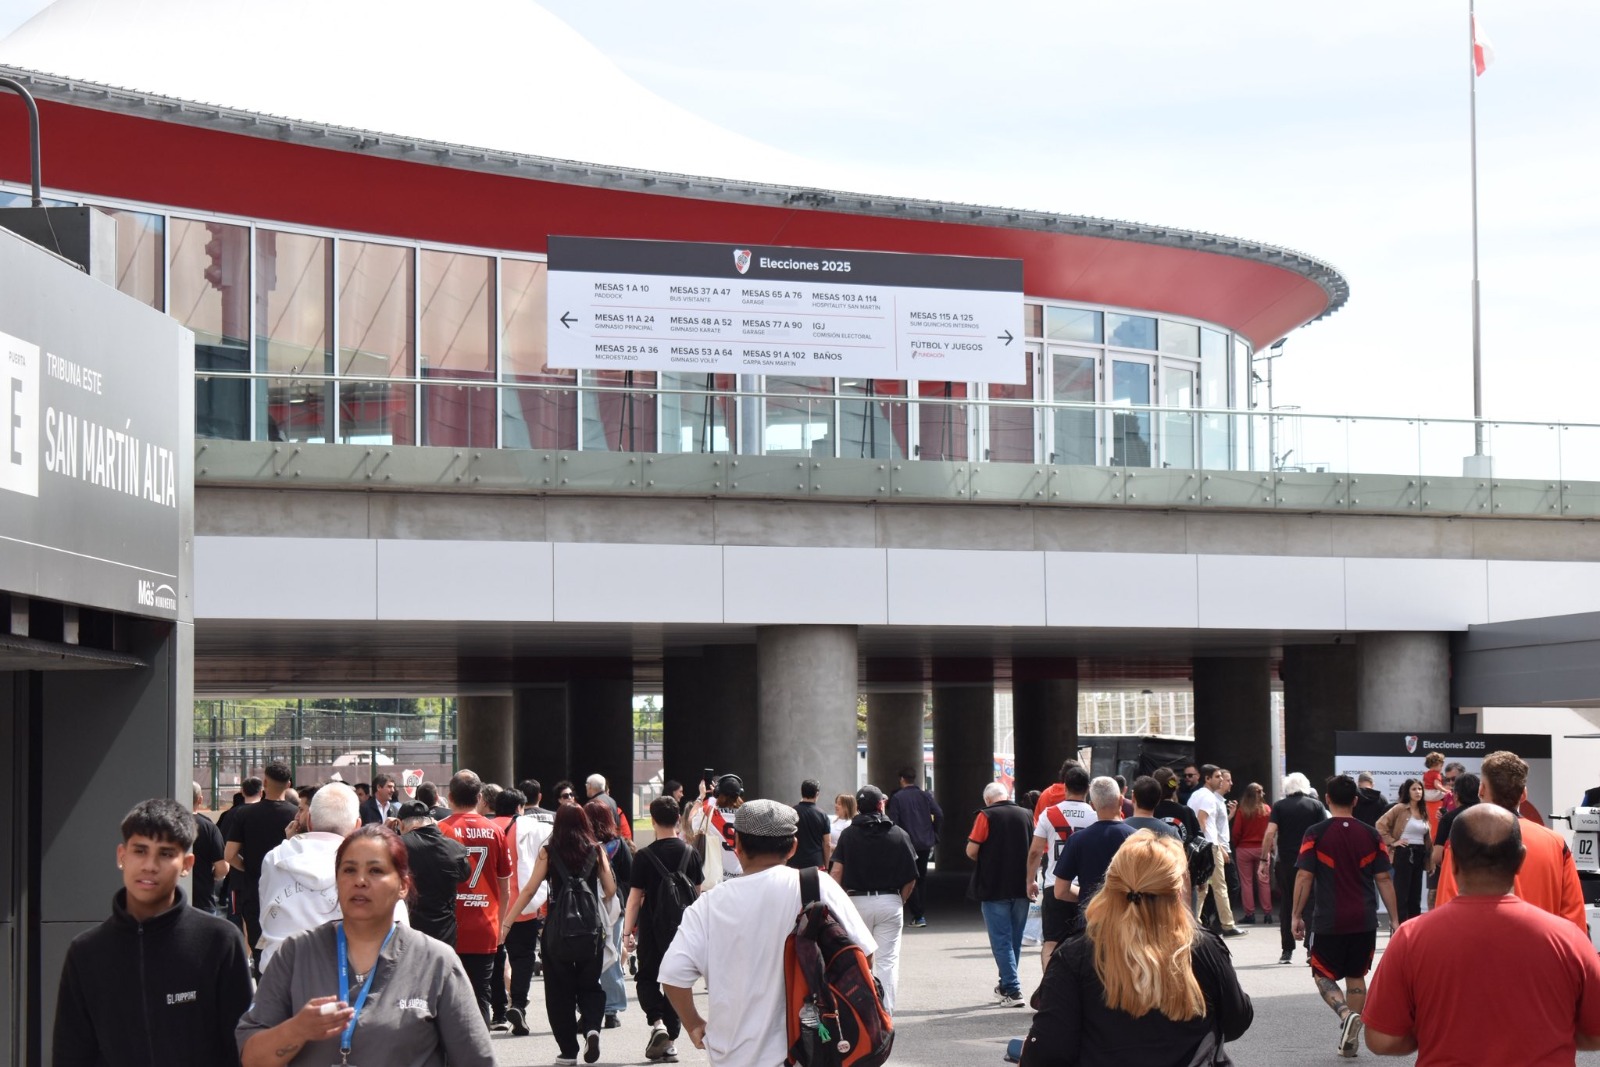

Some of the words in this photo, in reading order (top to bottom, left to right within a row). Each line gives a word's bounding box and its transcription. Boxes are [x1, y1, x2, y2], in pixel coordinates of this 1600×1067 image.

[760, 257, 819, 271] Elecciones
[822, 260, 852, 272] 2025
[594, 283, 624, 292] MESAS
[670, 286, 698, 294] MESAS
[742, 290, 770, 298] MESAS
[812, 292, 840, 301] MESAS
[595, 314, 624, 322] MESAS
[910, 312, 937, 320] MESAS
[670, 317, 699, 325] MESAS
[742, 320, 770, 328] MESAS
[596, 344, 624, 352] MESAS
[910, 340, 942, 350] FÚTBOL
[671, 347, 699, 355] MESAS
[743, 350, 771, 358] MESAS
[814, 351, 842, 360] BAÑOS
[8, 351, 26, 366] PUERTA
[46, 352, 82, 387] TRIBUNA
[83, 368, 102, 395] ESTE
[10, 376, 23, 466] E
[46, 406, 78, 478] SAN
[83, 418, 140, 497] MARTÍN
[144, 443, 176, 508] ALTA
[1422, 740, 1464, 750] Elecciones
[1466, 741, 1486, 750] 2025
[454, 828, 464, 838] M.
[466, 828, 495, 840] SUAREZ
[1580, 840, 1592, 854] 02
[465, 846, 488, 888] 7
